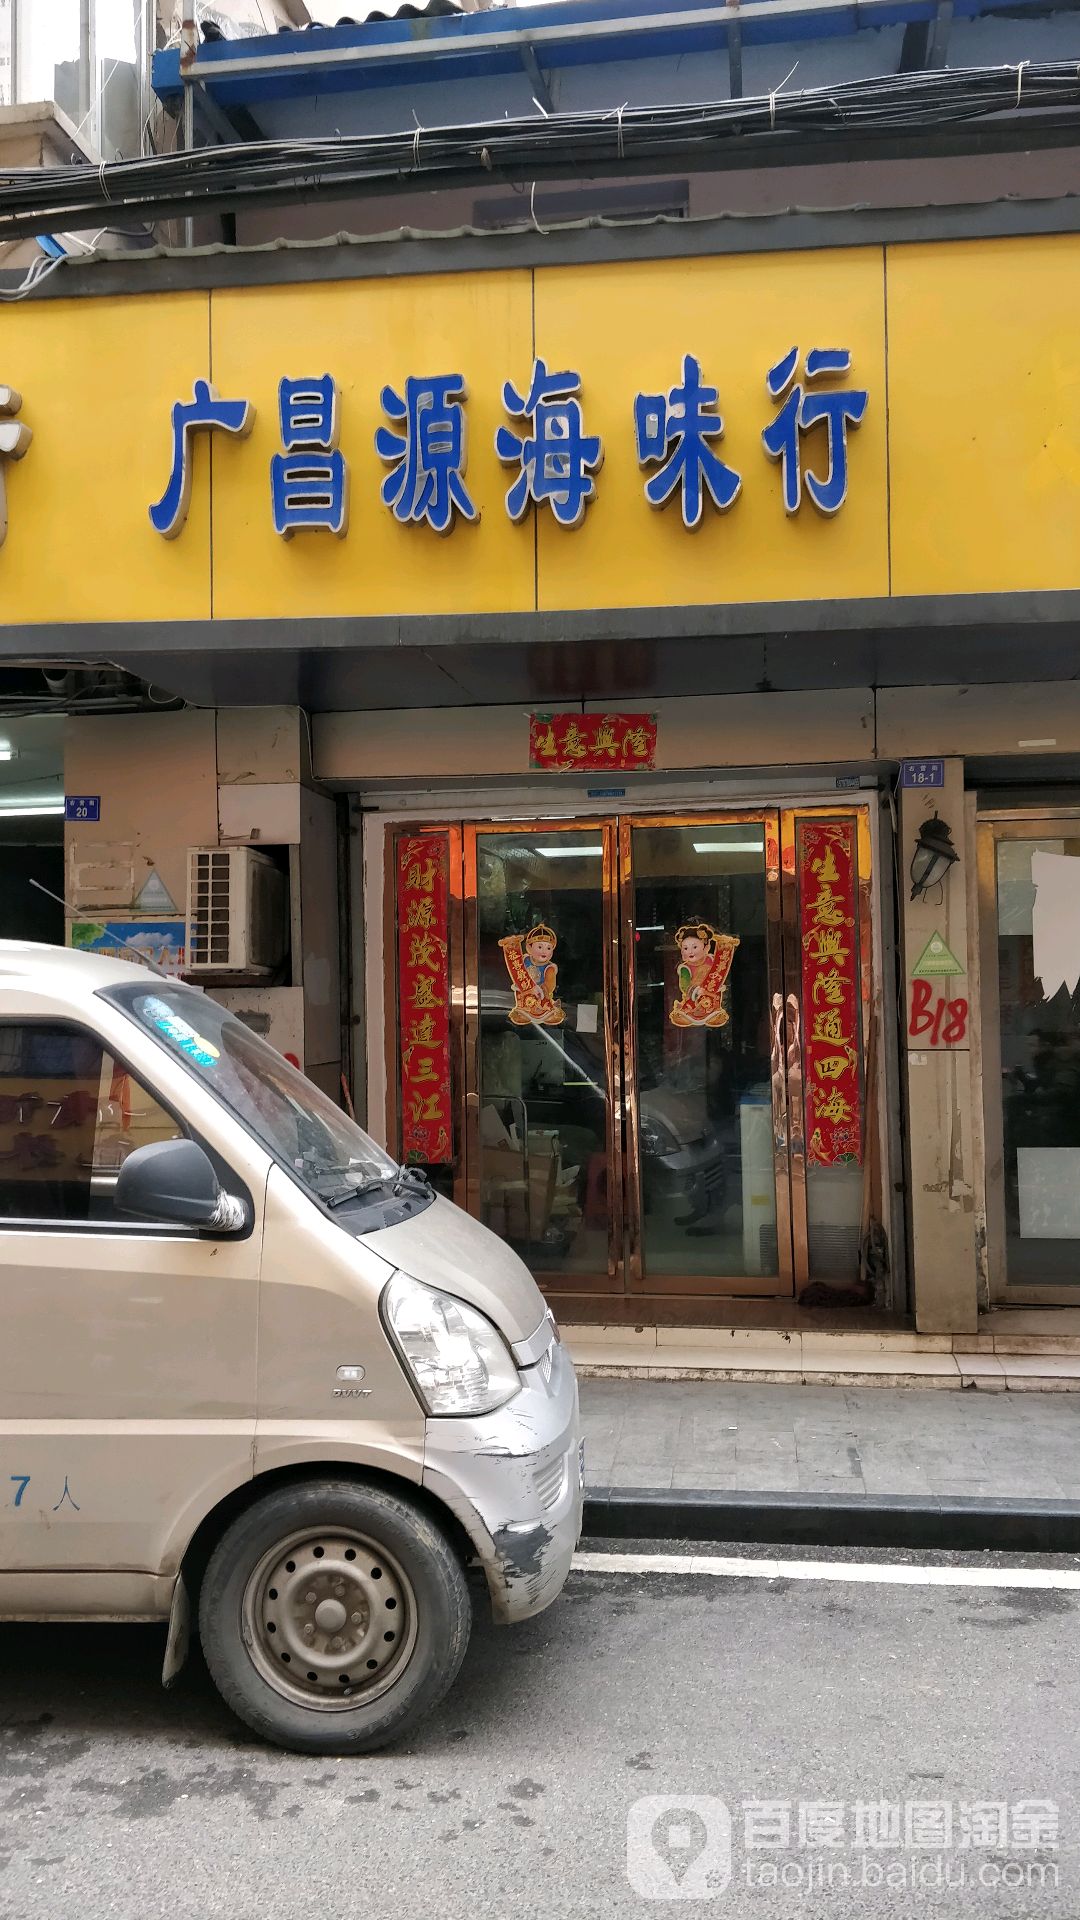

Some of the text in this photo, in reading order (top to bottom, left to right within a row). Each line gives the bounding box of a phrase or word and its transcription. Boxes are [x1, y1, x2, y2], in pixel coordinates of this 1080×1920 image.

[148, 346, 868, 540] 广昌源海味行
[911, 772, 935, 784] 18-1
[76, 806, 88, 817] 20
[805, 845, 852, 1123] 生意興隆通四海
[909, 978, 968, 1046] B18
[10, 1475, 81, 1511] 7 人
